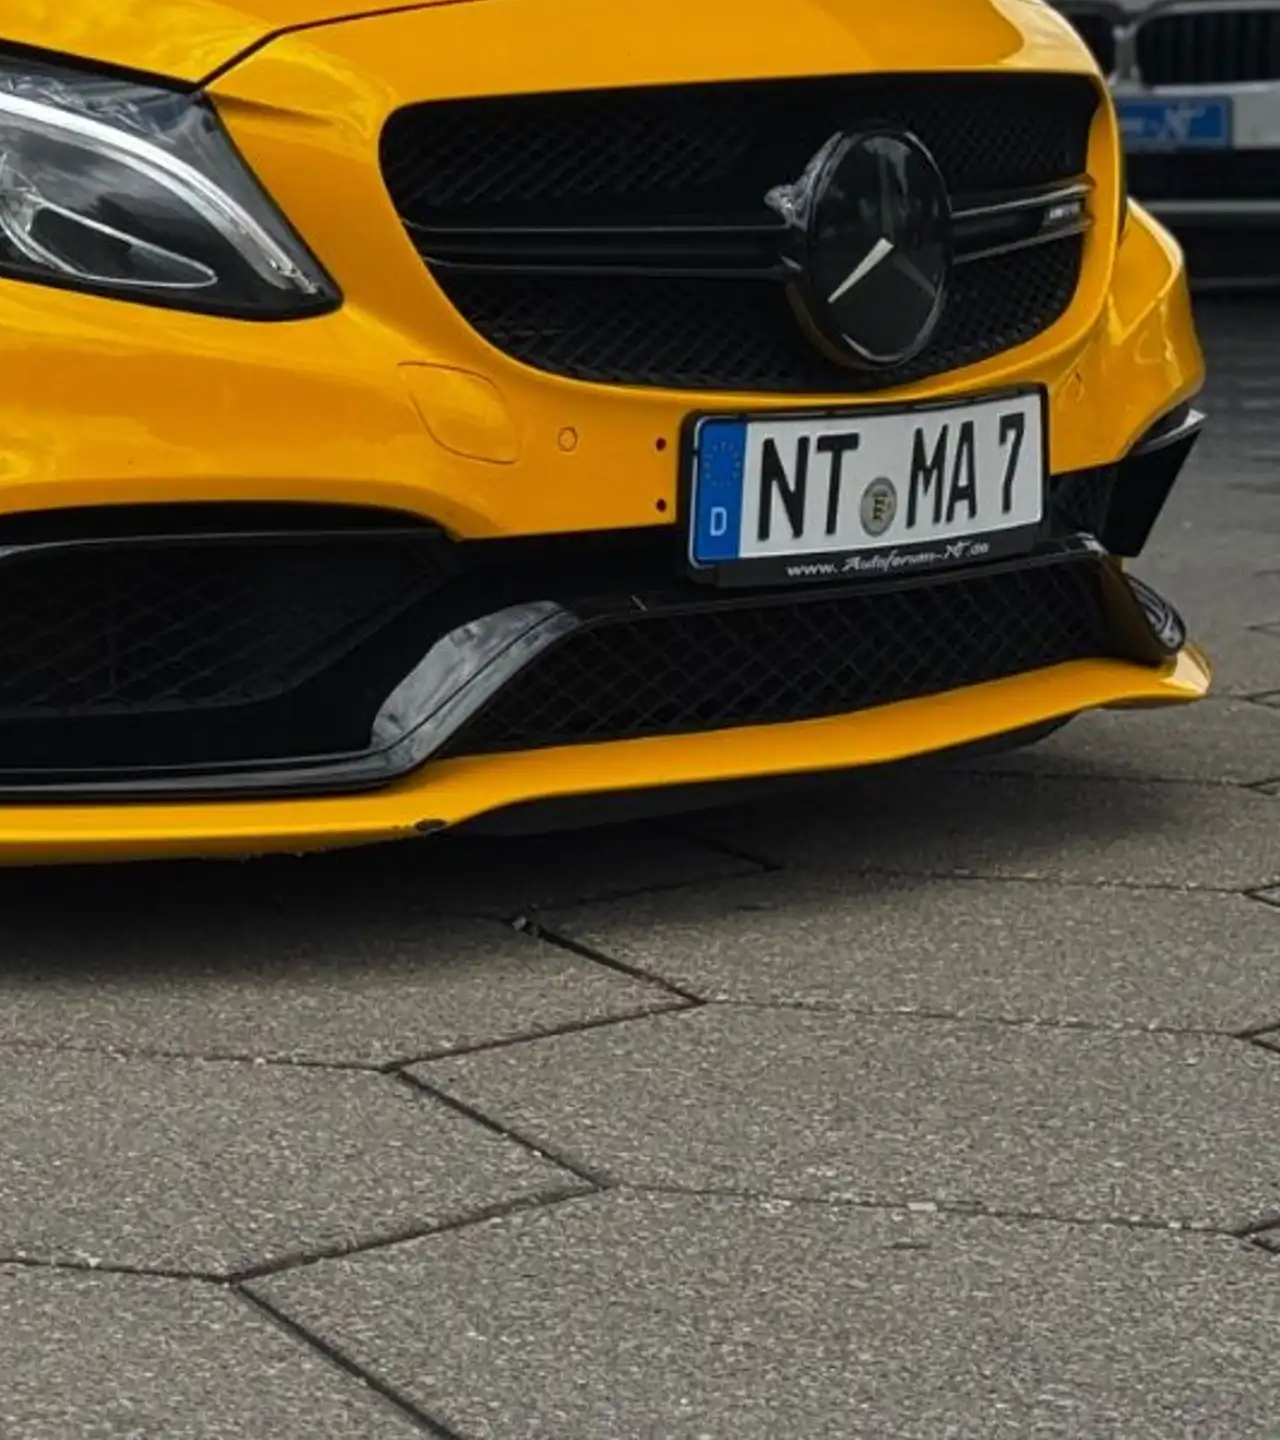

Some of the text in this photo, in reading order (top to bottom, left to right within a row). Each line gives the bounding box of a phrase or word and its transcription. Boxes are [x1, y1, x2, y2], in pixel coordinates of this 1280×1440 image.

[757, 411, 1026, 542] NT MA 7
[709, 506, 728, 537] D
